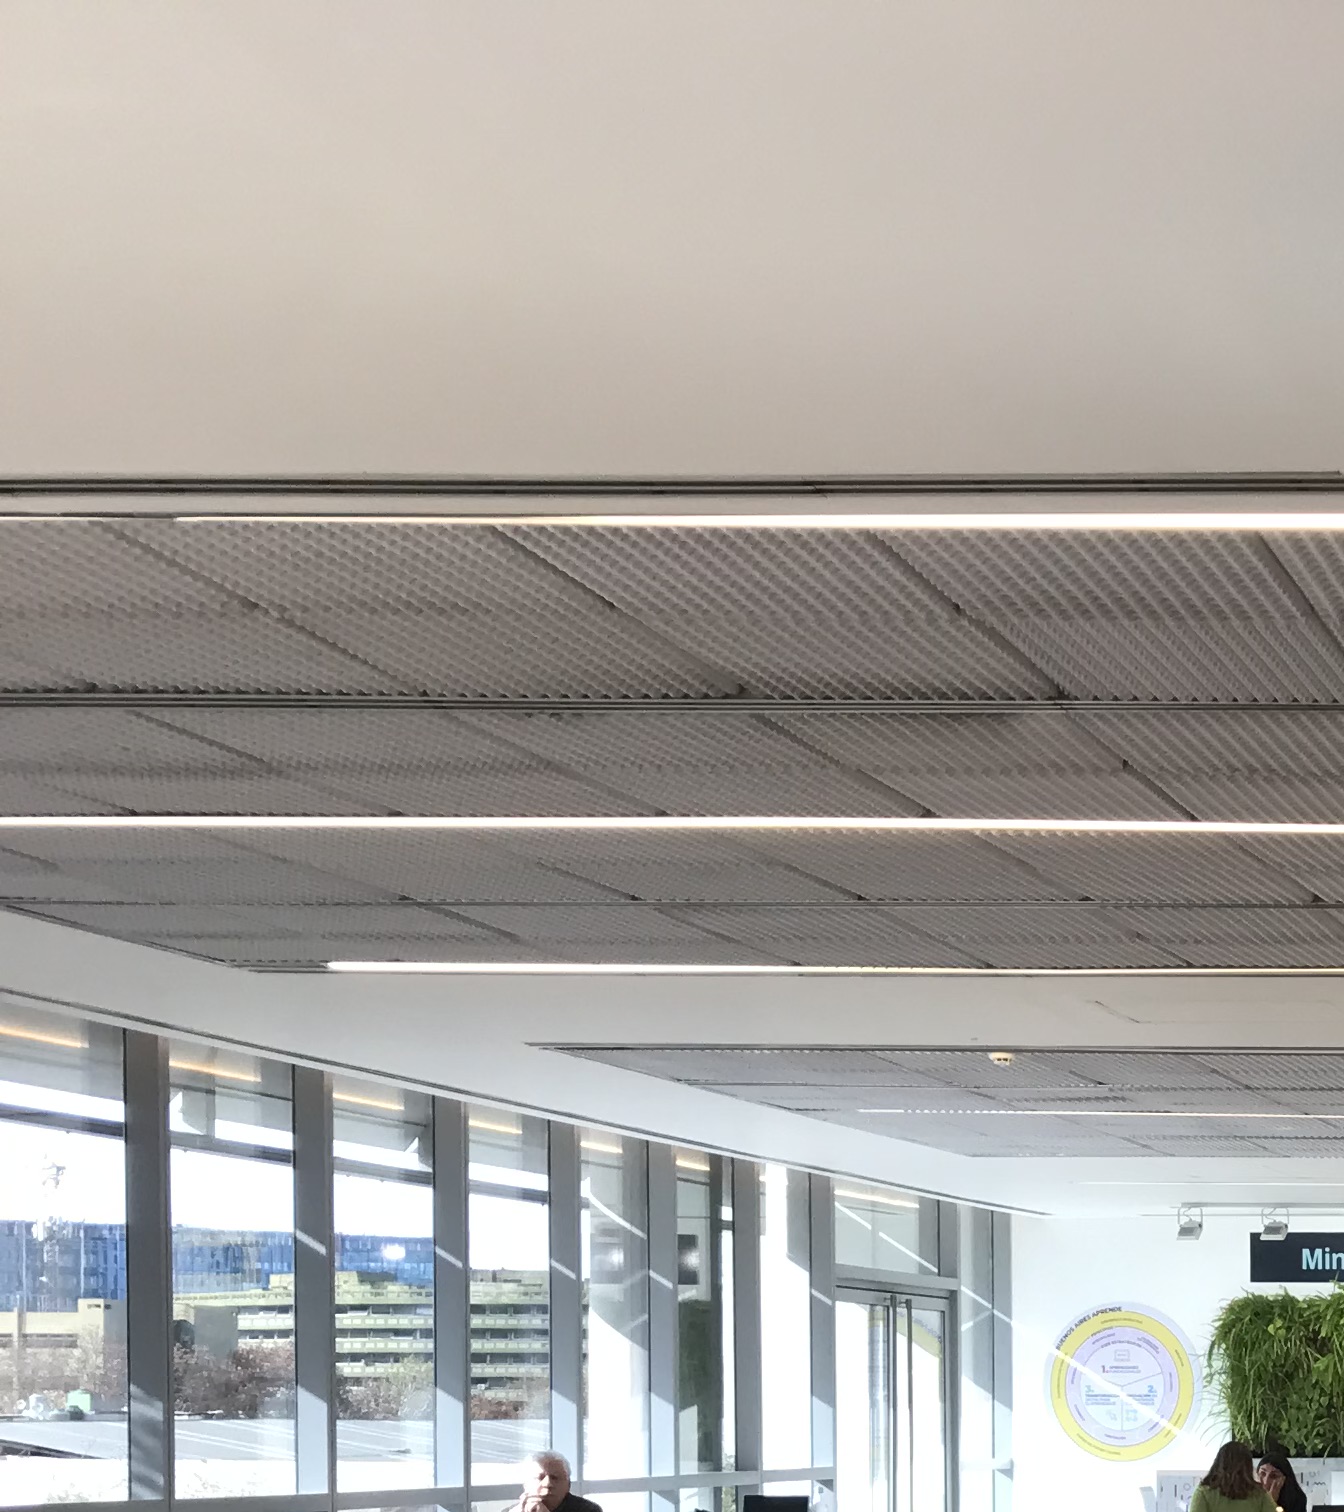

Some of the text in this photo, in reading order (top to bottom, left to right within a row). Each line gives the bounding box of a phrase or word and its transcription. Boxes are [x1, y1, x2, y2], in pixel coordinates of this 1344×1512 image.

[1055, 1327, 1075, 1350] BUENOS
[1074, 1314, 1092, 1331] AIRES
[1091, 1306, 1123, 1317] APRENDE
